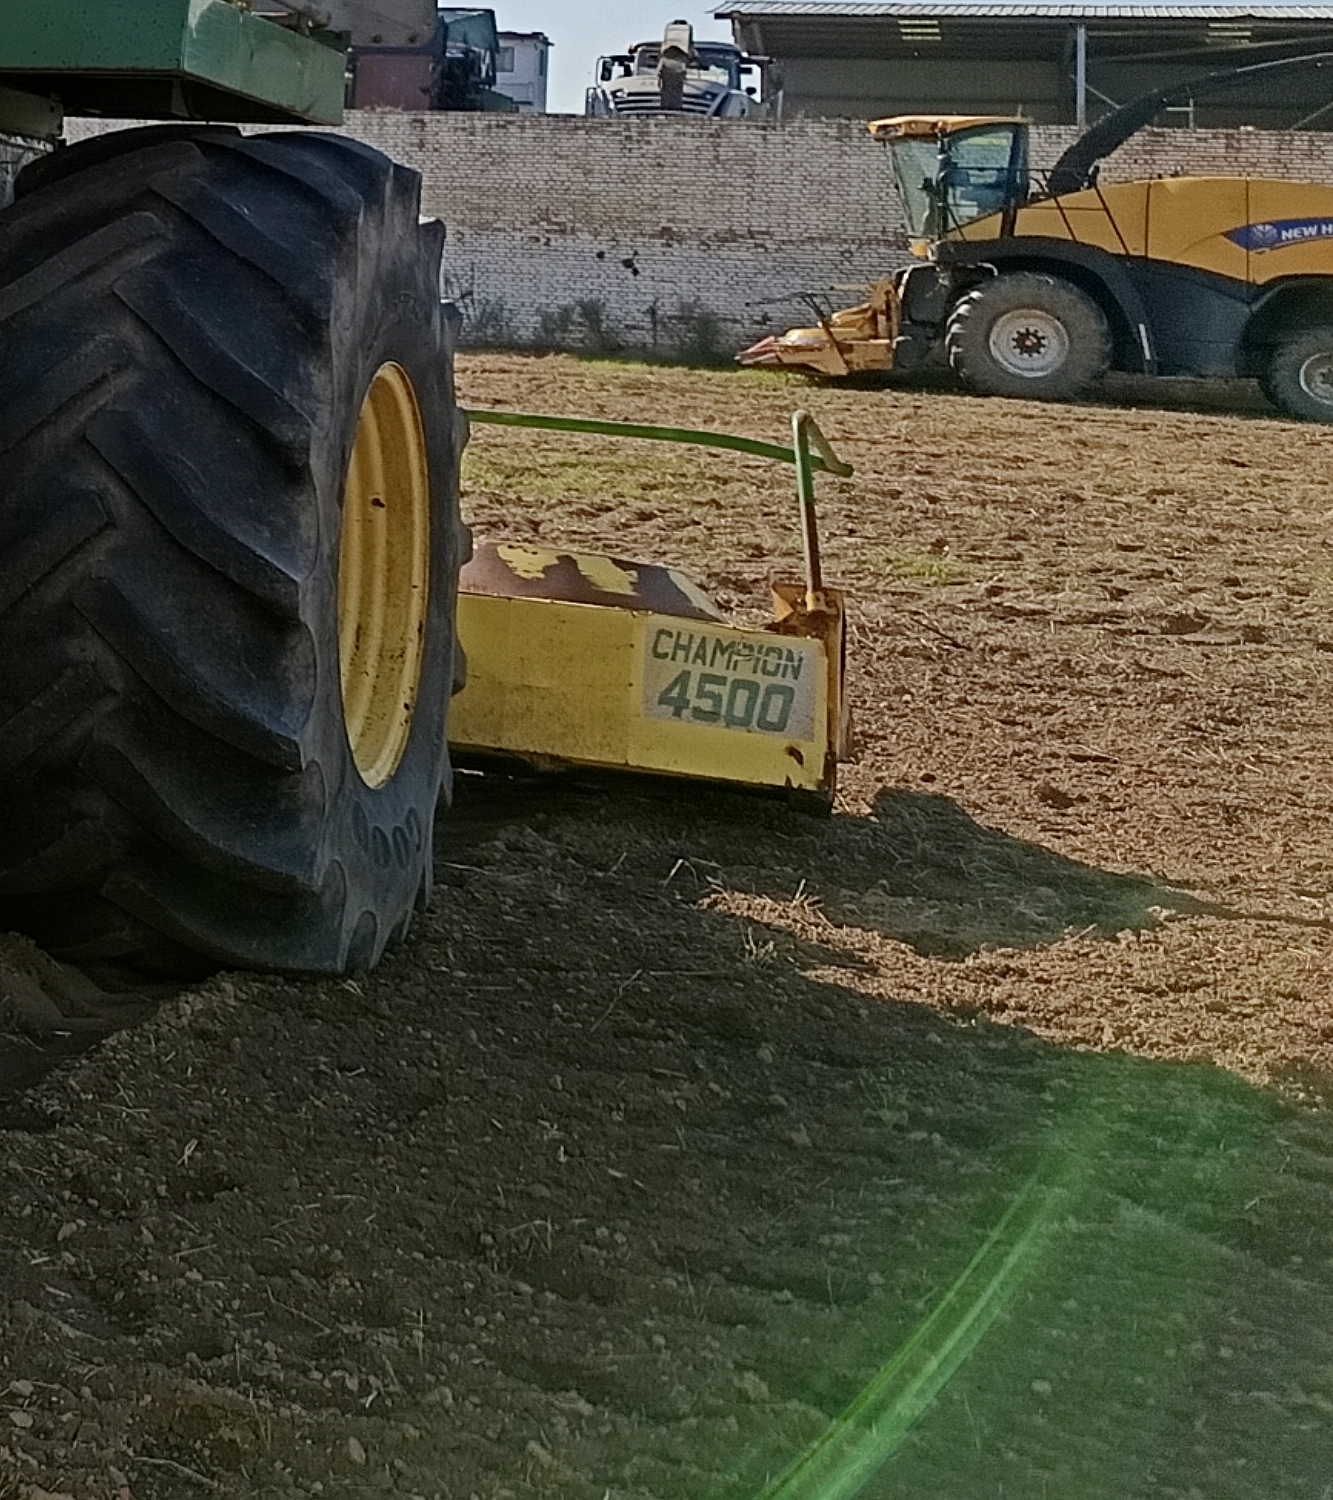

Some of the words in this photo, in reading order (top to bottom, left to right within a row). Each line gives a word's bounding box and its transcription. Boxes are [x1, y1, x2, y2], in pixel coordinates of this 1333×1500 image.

[1281, 225, 1318, 240] NEW
[651, 628, 803, 680] CHAMPION
[657, 668, 795, 733] 4500
